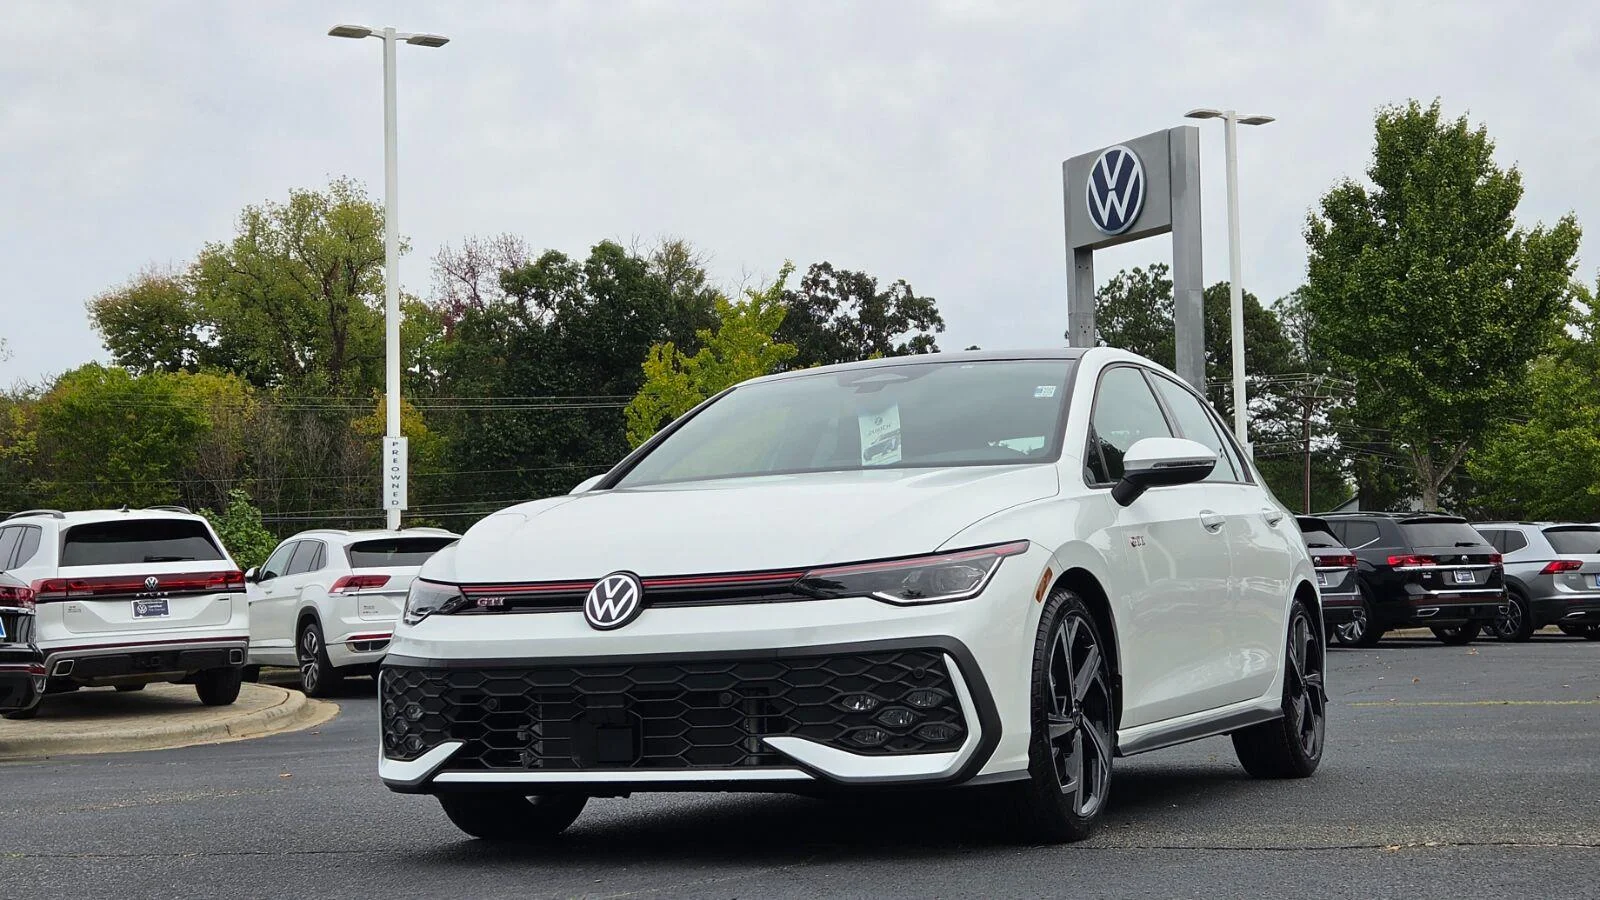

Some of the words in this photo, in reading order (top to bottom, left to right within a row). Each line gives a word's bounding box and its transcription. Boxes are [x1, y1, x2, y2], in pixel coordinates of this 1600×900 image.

[1088, 148, 1141, 229] VW
[390, 441, 401, 506] PREOWNED
[476, 597, 506, 607] GTI
[589, 576, 636, 623] VW
